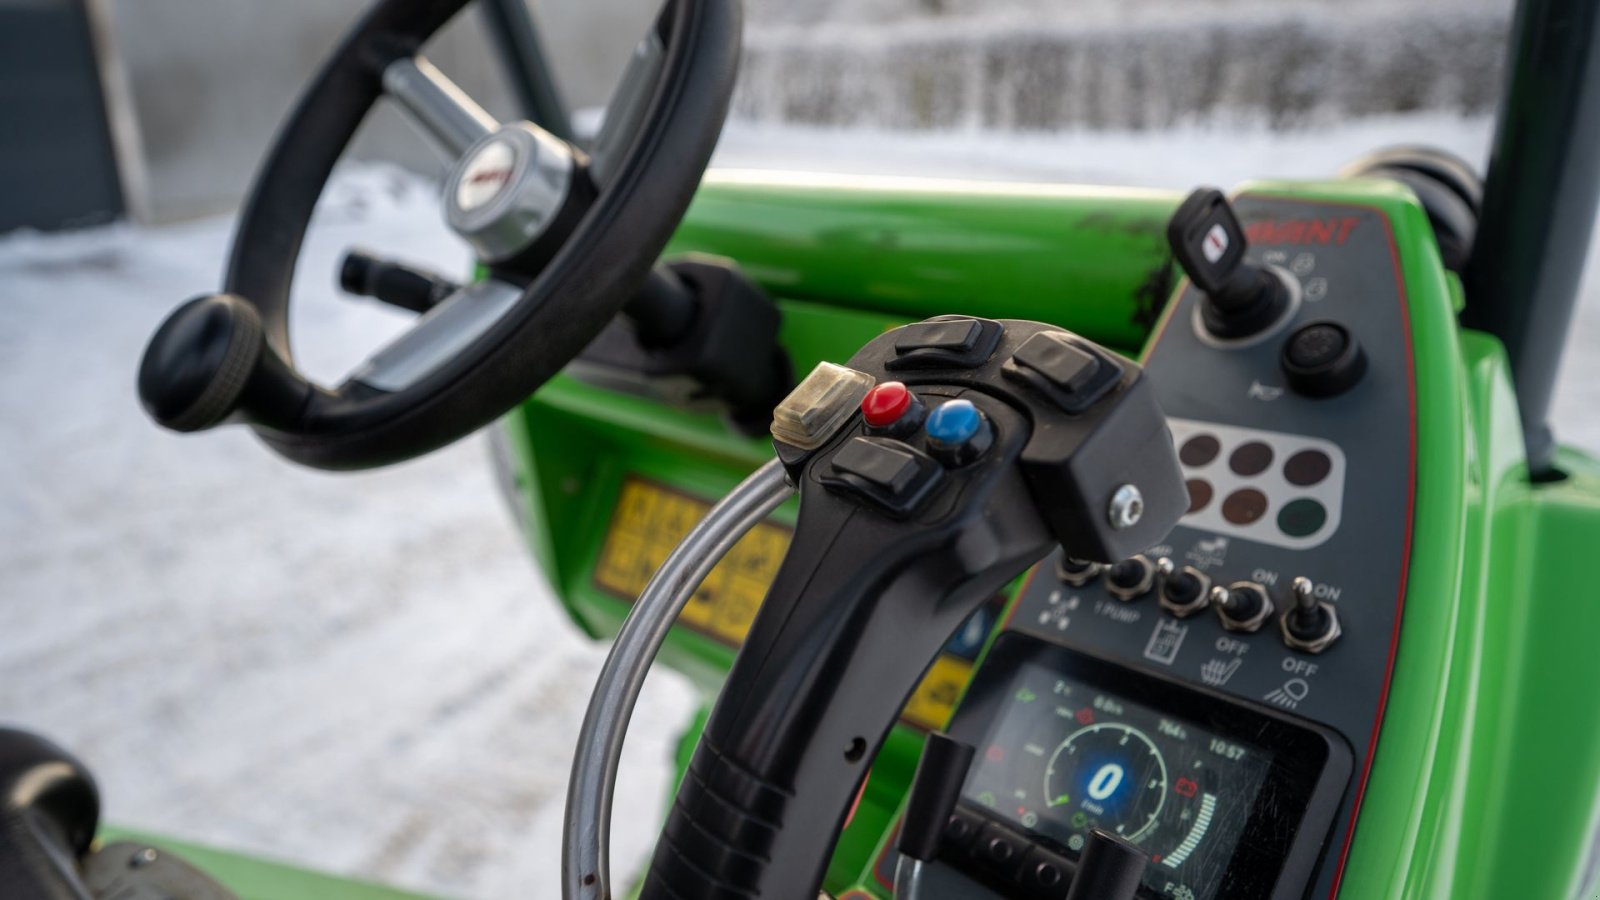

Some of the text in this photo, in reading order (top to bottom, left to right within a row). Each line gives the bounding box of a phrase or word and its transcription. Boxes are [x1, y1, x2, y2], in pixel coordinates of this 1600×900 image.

[1252, 569, 1279, 586] ON
[1314, 583, 1342, 602] ON
[1215, 636, 1250, 656] OFF
[1282, 657, 1318, 677] OFF
[1210, 738, 1246, 761] 10:57
[1088, 763, 1124, 801] 0
